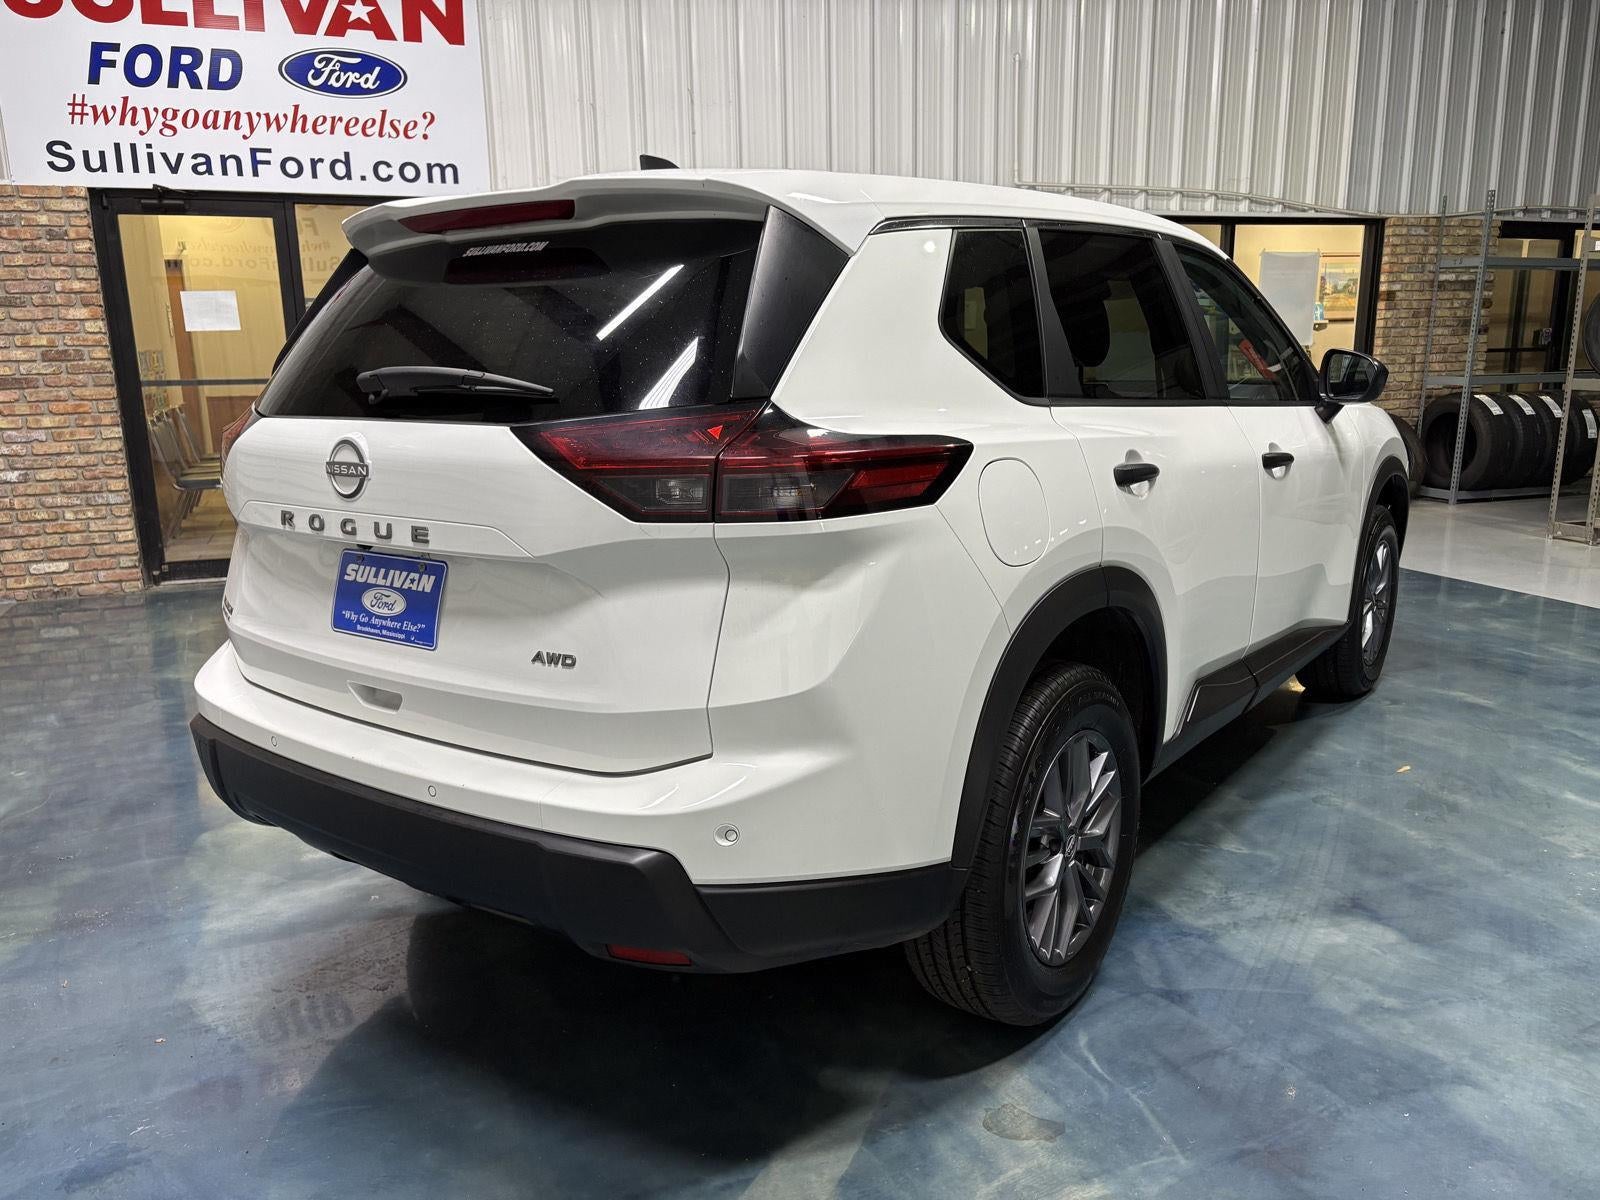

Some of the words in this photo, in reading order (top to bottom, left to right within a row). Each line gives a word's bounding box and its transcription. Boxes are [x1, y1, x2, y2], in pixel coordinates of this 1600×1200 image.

[87, 41, 243, 91] FORD
[307, 53, 381, 90] Ford
[67, 93, 436, 140] #whygoanywhereelse?
[45, 139, 460, 185] SullivanFord.com
[326, 464, 368, 475] NISSAN
[280, 510, 430, 544] ROGUE
[344, 563, 436, 592] SULLIVAN
[370, 592, 396, 611] Ford
[342, 610, 358, 623] "Why
[360, 612, 369, 624] Go
[370, 616, 401, 629] Anywhere
[402, 620, 426, 633] Else?"
[382, 629, 405, 639] Mississippi
[531, 650, 577, 669] AWD
